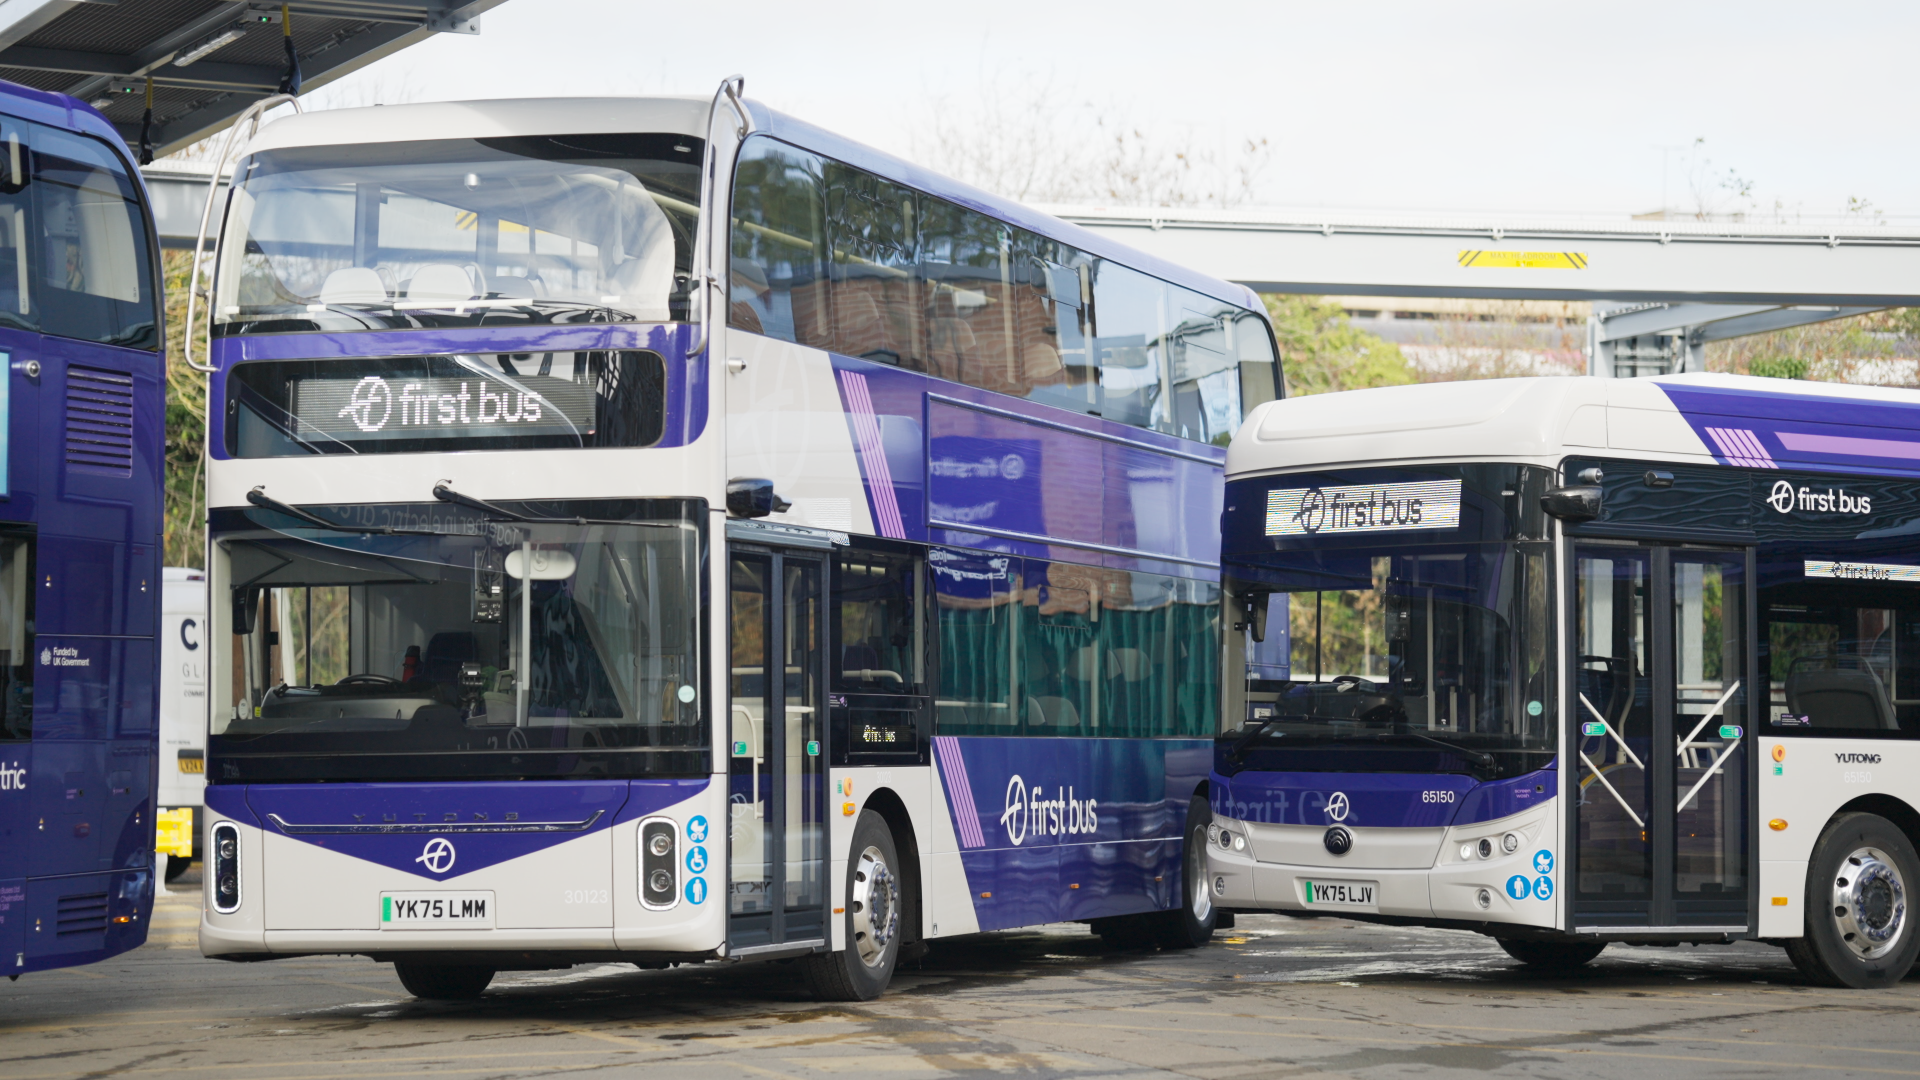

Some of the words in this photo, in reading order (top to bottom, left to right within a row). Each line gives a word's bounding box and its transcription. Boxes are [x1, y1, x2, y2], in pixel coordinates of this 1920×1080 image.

[1511, 252, 1556, 260] HEADROOM
[399, 382, 471, 425] first
[477, 381, 542, 424] bus
[1798, 487, 1835, 511] first
[1839, 489, 1871, 514] bus
[1330, 491, 1376, 528] first
[1380, 490, 1422, 525] bus
[1844, 564, 1870, 579] first
[1871, 565, 1890, 580] bus
[180, 618, 205, 651] C
[53, 647, 71, 657] Funded
[71, 647, 78, 658] by
[53, 657, 61, 666] UK
[62, 657, 90, 666] Government
[182, 663, 205, 679] GL
[1835, 753, 1881, 764] YUTONG
[1844, 771, 1872, 783] 65150
[1422, 790, 1455, 803] 65150
[352, 812, 519, 823] YUTONG
[1031, 785, 1066, 836] first
[1068, 785, 1098, 835] bus
[564, 890, 608, 904] 30123
[1314, 884, 1346, 902] YK75
[1348, 886, 1372, 903] LJV
[395, 899, 443, 918] YK75
[449, 899, 486, 918] LMM
